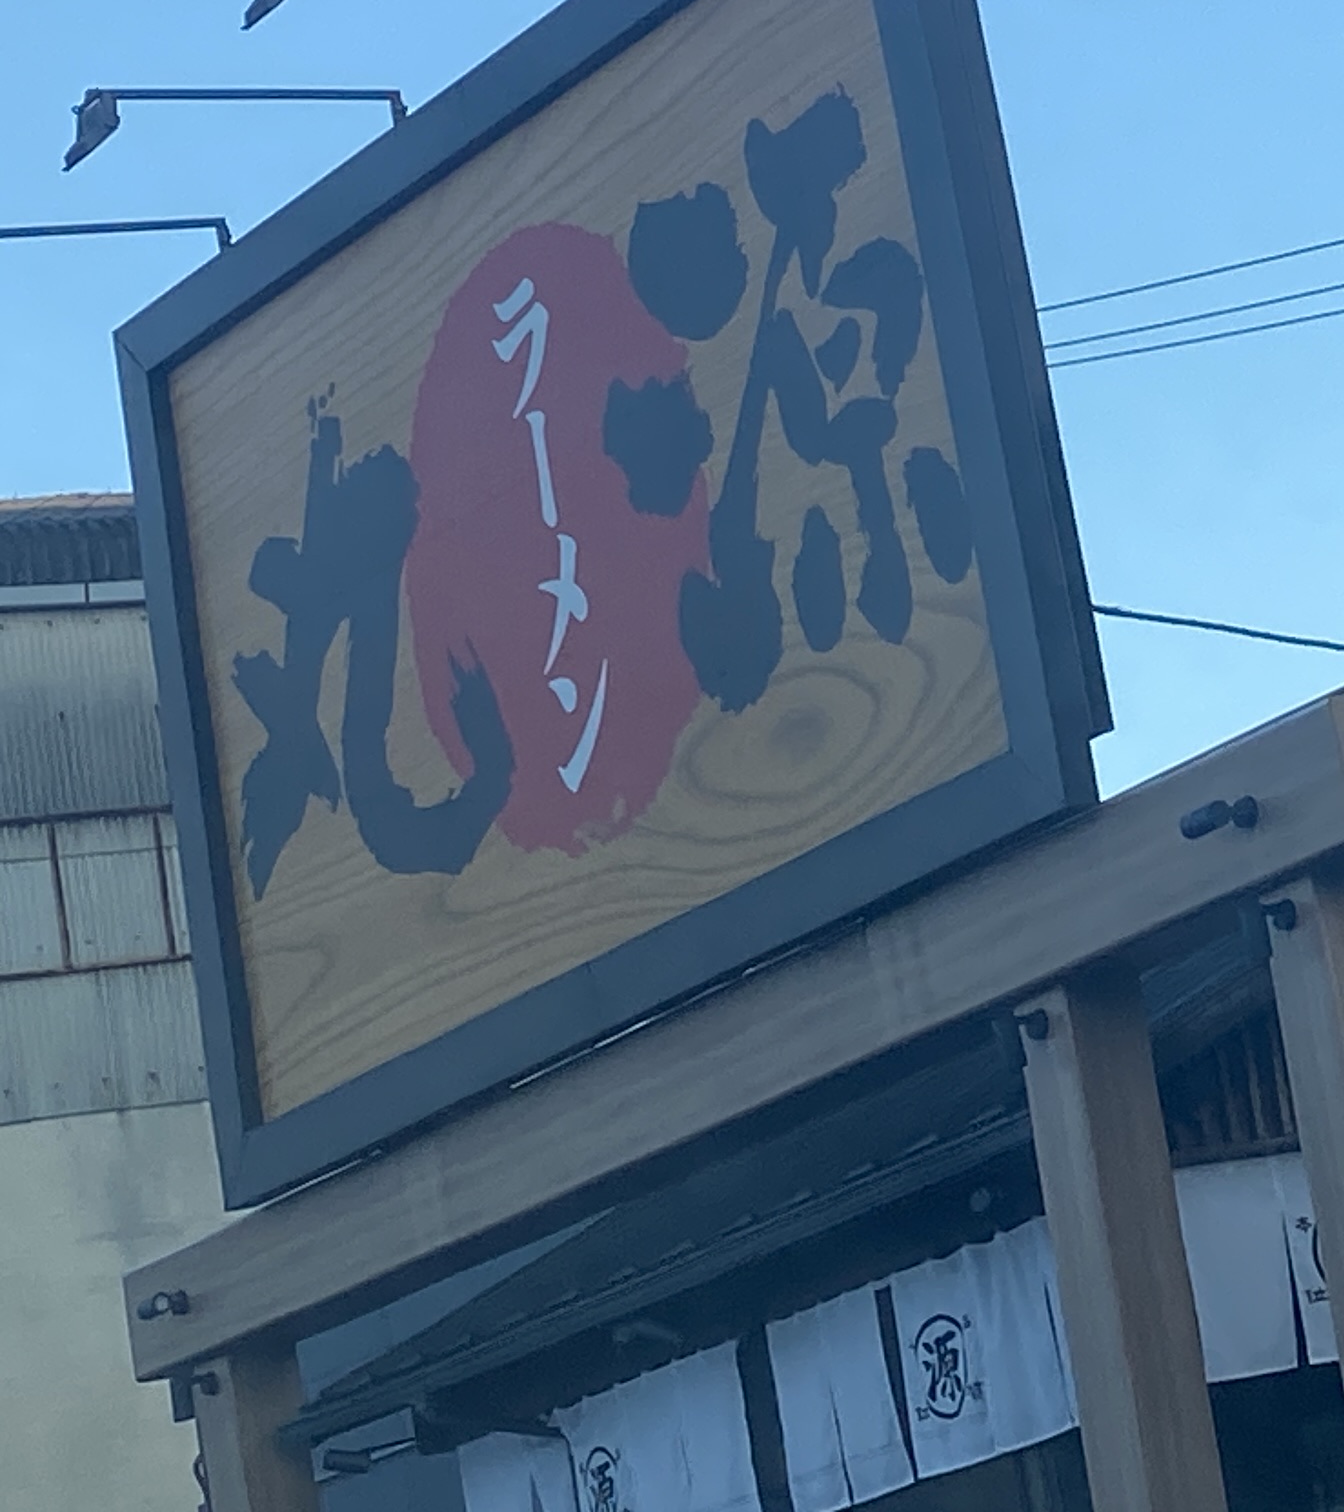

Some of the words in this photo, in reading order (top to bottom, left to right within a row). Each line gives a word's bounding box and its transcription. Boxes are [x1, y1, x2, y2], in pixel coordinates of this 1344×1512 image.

[232, 90, 972, 899] 丸源
[491, 276, 614, 794] ラーメン
[921, 1329, 962, 1403] 源
